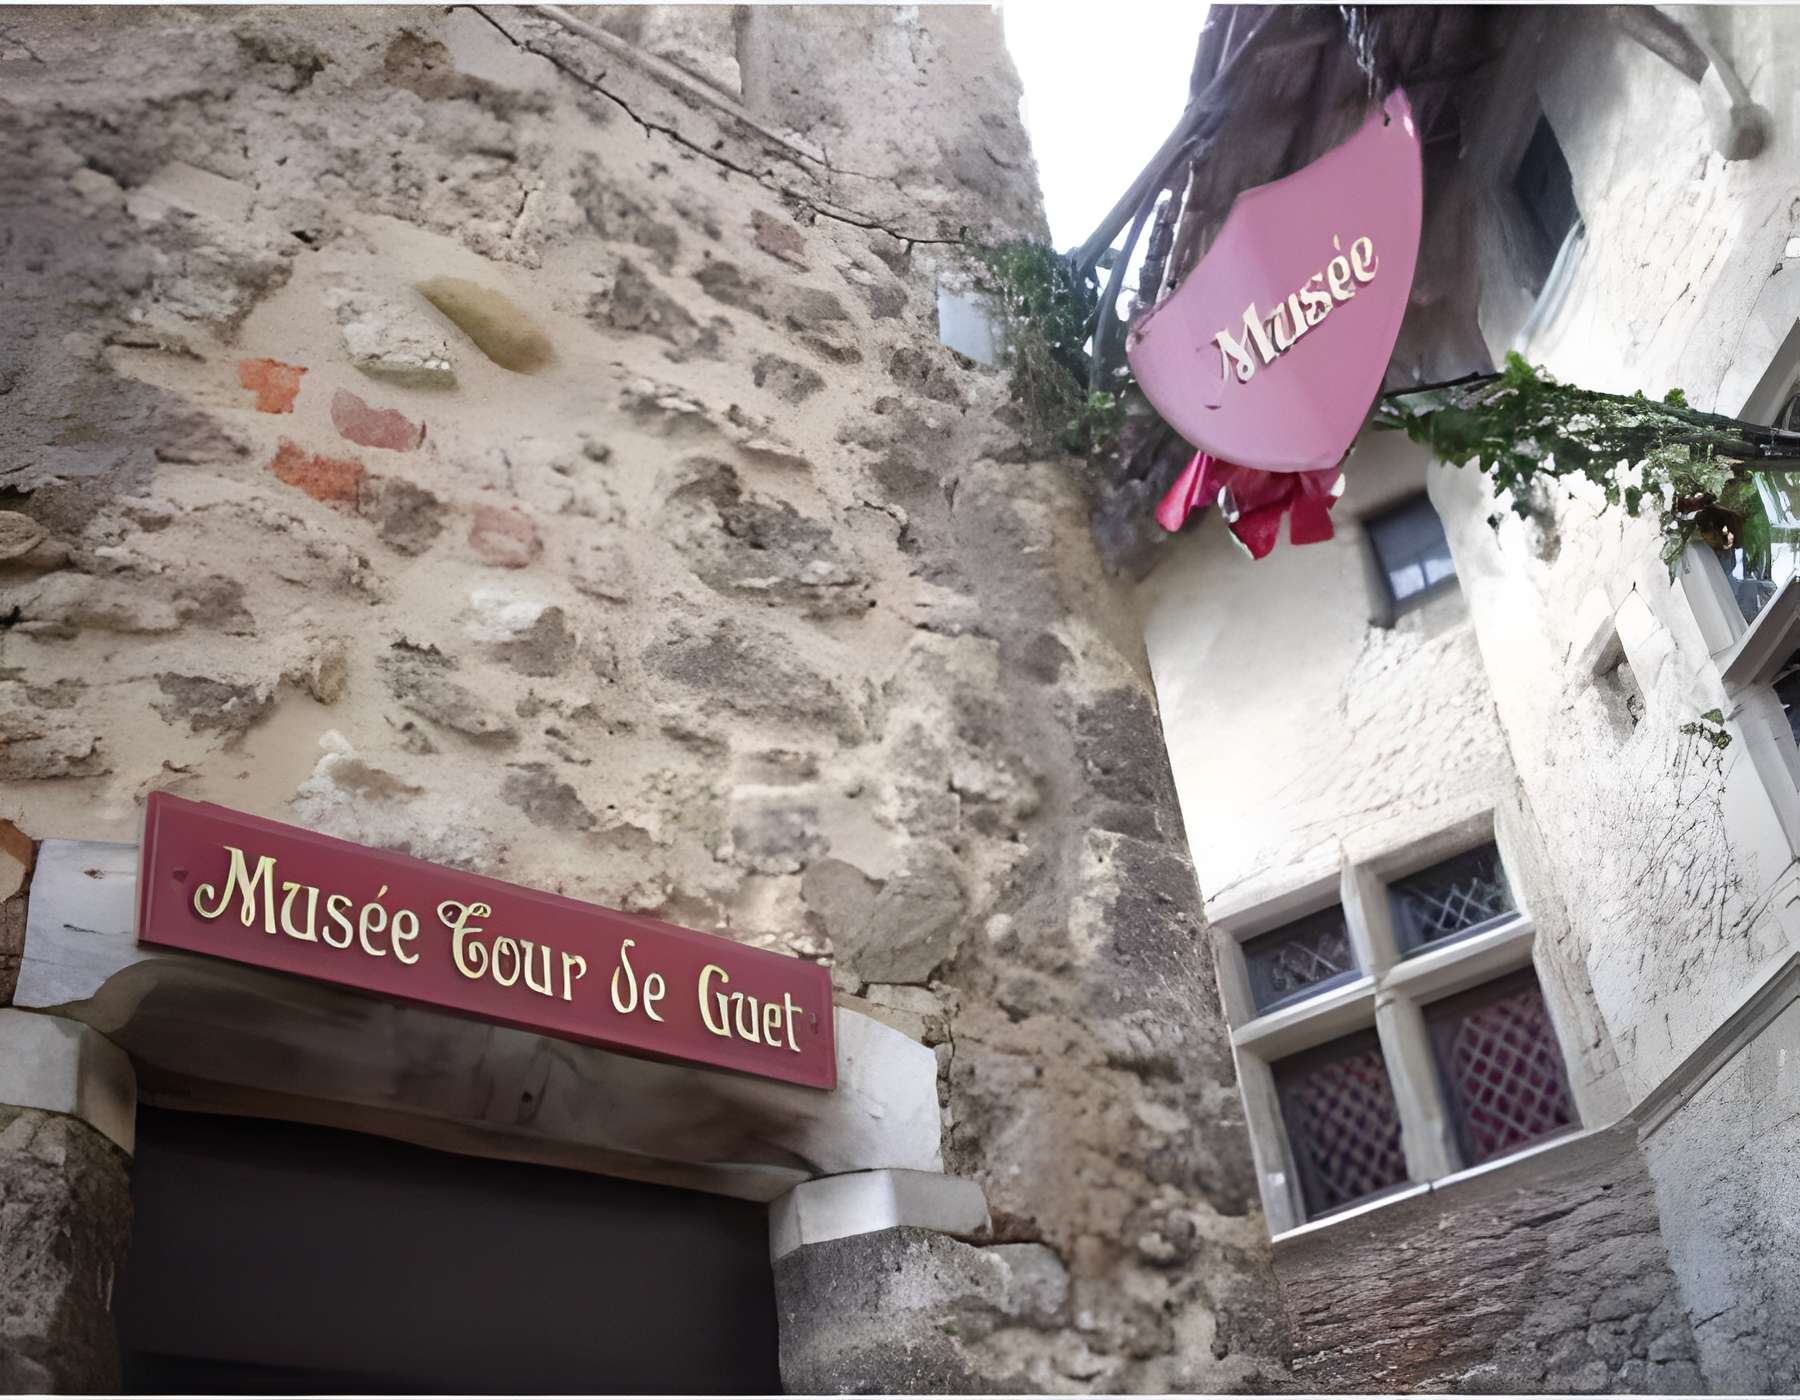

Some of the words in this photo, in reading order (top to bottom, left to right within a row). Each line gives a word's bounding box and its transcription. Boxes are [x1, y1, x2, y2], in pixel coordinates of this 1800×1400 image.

[1210, 233, 1379, 388] Musée
[193, 845, 420, 965] Musée
[437, 900, 587, 1001] Tour
[611, 938, 666, 1022] de
[698, 964, 803, 1052] Guet
